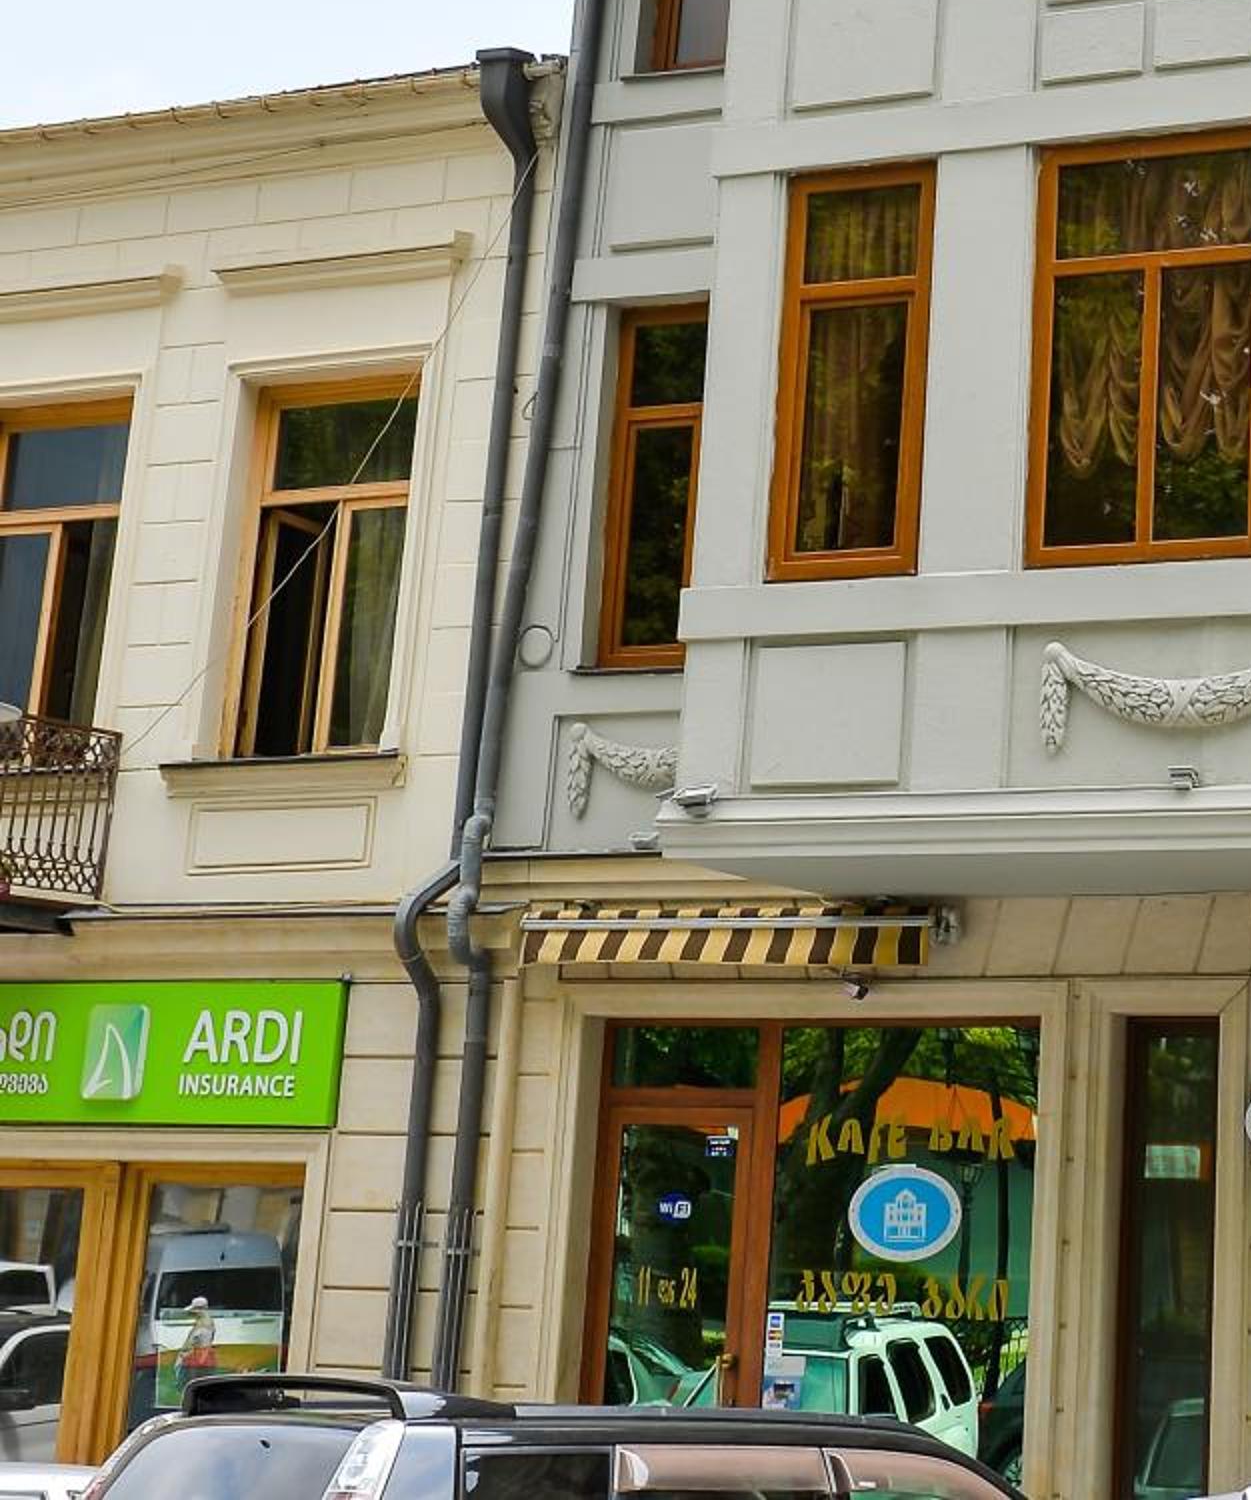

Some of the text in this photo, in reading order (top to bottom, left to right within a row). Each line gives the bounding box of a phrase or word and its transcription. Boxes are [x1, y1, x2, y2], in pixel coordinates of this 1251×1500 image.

[182, 1008, 303, 1065] ARDI
[178, 1073, 296, 1098] INSURANCE
[806, 1113, 1015, 1166] KAFE BAR
